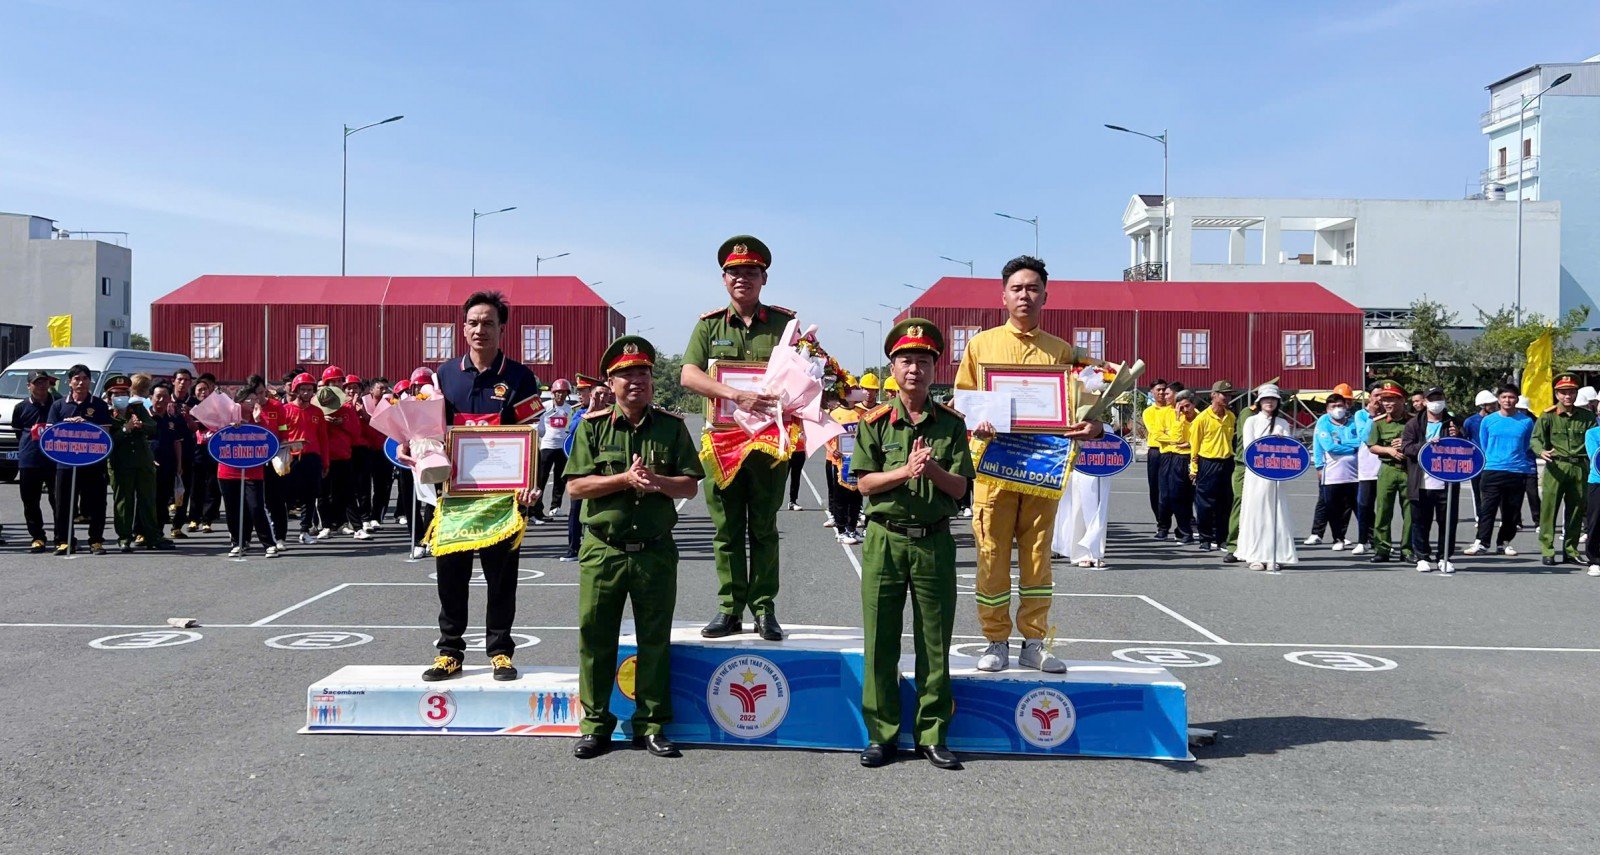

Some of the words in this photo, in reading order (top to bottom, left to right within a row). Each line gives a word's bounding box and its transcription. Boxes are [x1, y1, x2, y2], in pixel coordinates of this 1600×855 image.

[219, 444, 231, 458] XÃ
[233, 444, 254, 458] BÌNH
[1087, 452, 1105, 466] PHÚ
[1457, 458, 1473, 473] PHÚ
[983, 460, 1000, 472] NHÌ
[1002, 466, 1027, 478] TOÀN
[1029, 472, 1057, 484] ĐOÀN
[427, 695, 448, 720] 3
